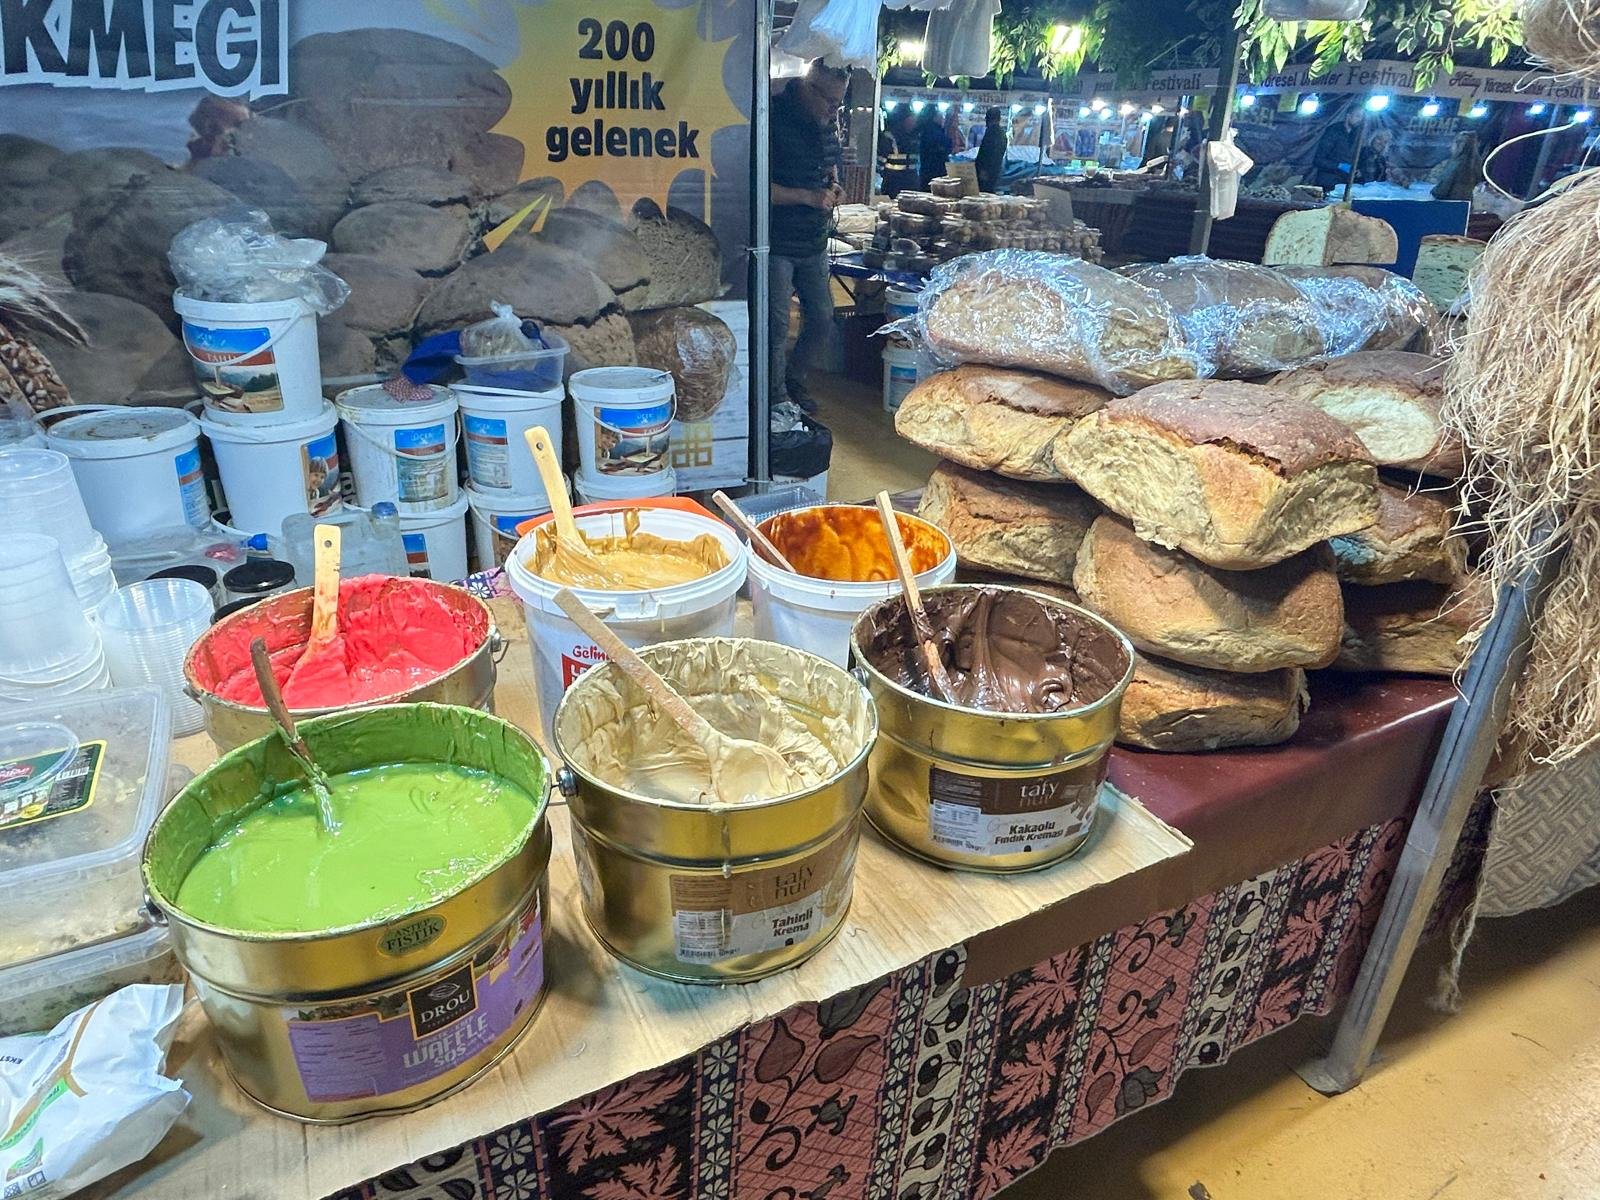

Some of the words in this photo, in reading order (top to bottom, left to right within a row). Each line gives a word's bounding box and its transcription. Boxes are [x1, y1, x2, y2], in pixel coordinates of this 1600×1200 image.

[578, 17, 655, 62] 200
[569, 71, 666, 114] yıllık
[545, 119, 700, 162] gelenek
[1009, 821, 1056, 835] Kakaolu
[1027, 828, 1064, 841] Kreması
[772, 907, 813, 929] Tahinli
[774, 922, 809, 937] Krema
[386, 921, 439, 950] FISTIK
[420, 990, 470, 1023] DROU
[402, 1012, 488, 1068] WAFFLE
